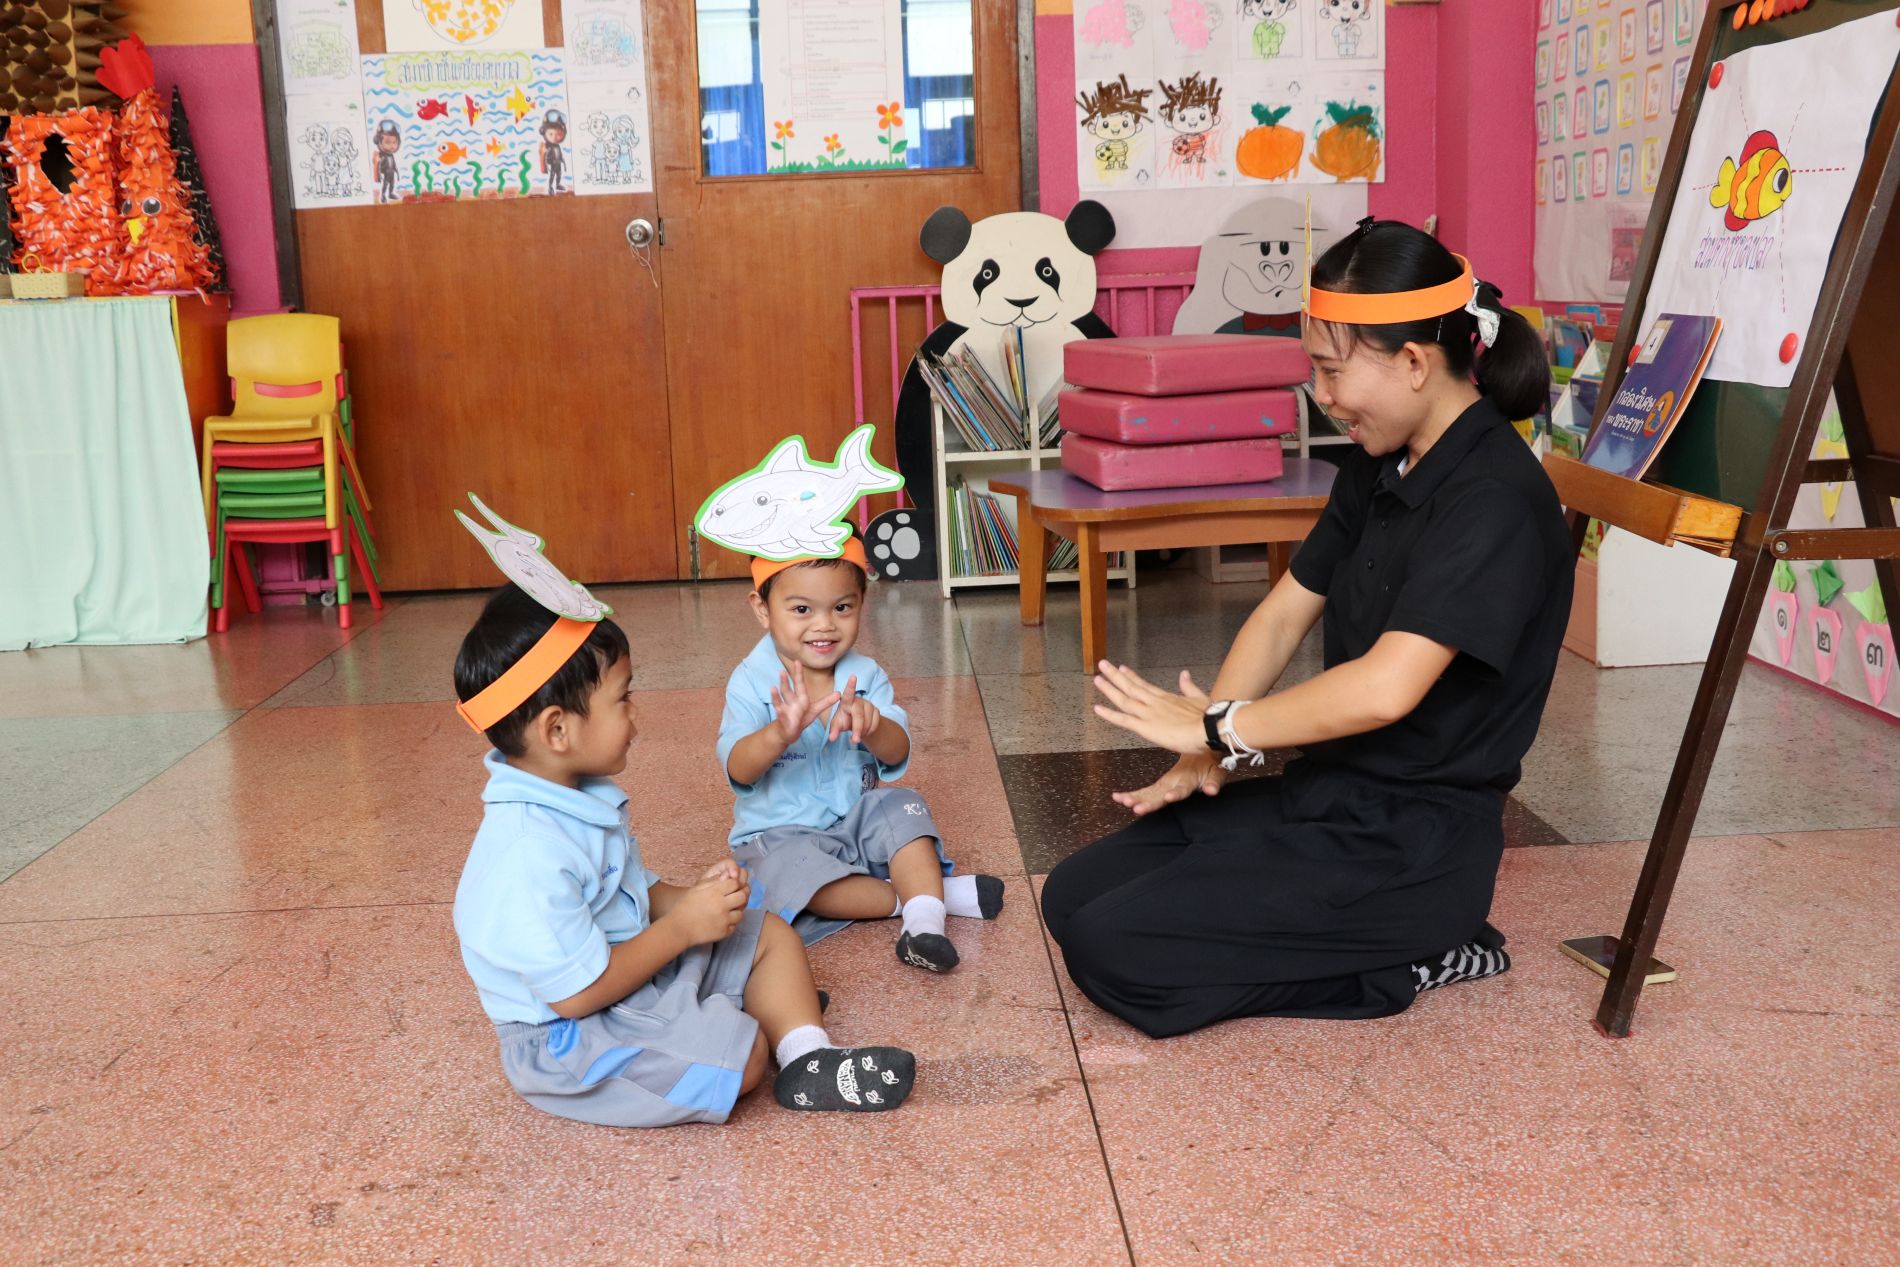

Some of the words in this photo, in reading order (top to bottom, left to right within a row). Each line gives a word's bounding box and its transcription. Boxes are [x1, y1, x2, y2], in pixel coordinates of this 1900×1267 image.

[1616, 387, 1657, 413] กล่องวิเศษ
[1612, 413, 1645, 435] พระราชา
[1815, 621, 1832, 653] ๒
[1866, 642, 1884, 668] ๓
